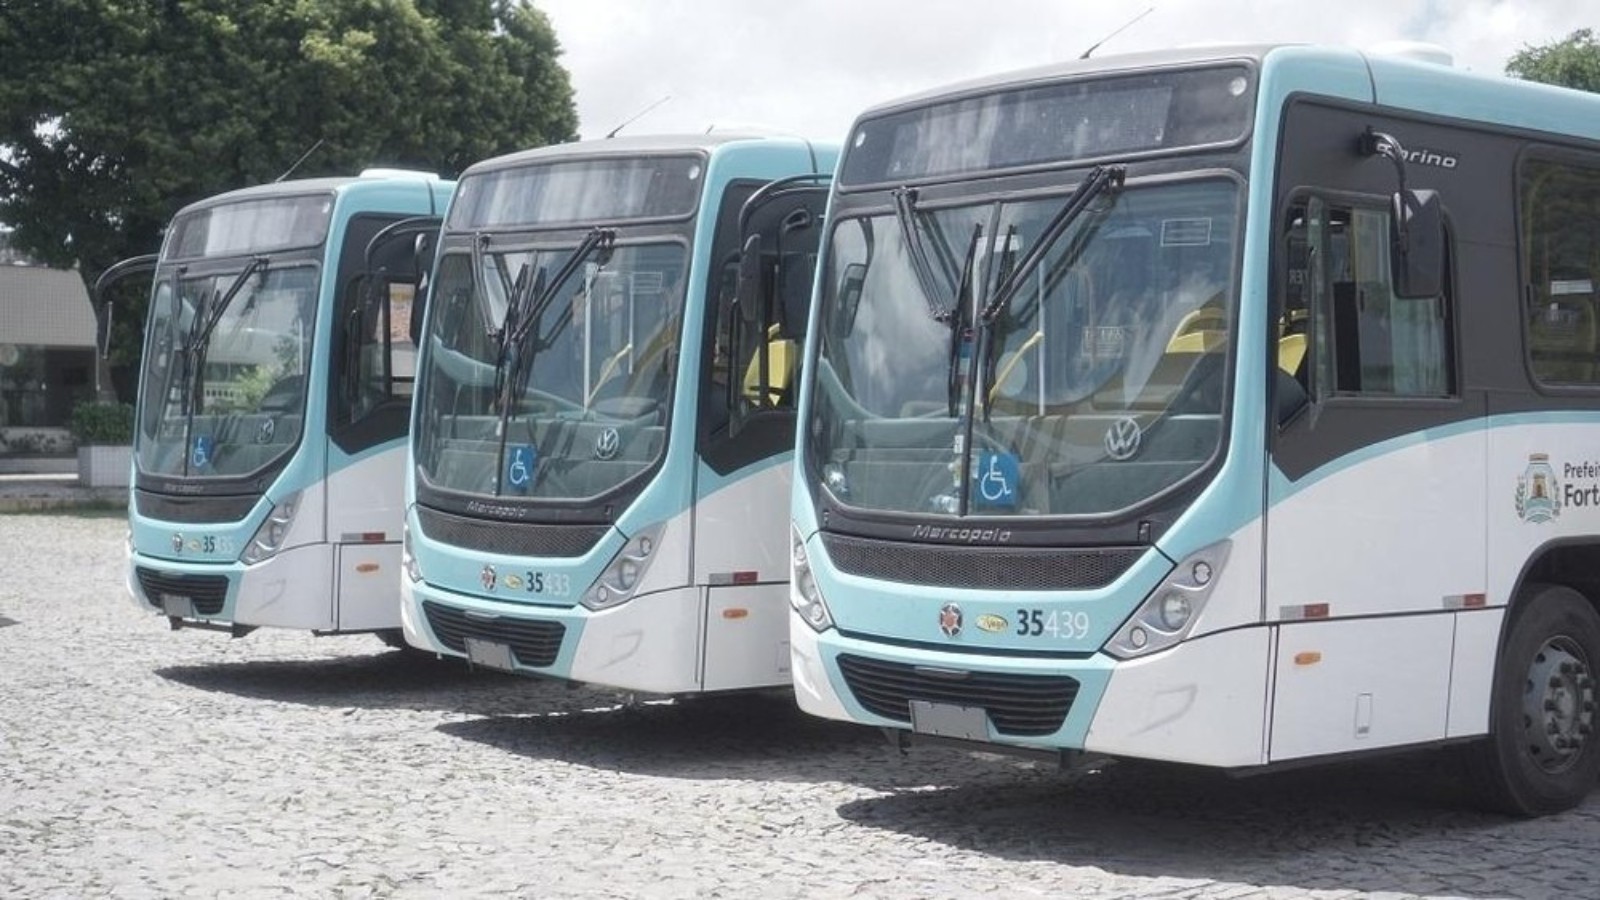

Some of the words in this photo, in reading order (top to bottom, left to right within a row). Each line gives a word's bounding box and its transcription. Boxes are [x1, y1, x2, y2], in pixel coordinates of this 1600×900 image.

[1564, 484, 1600, 507] Fort
[912, 524, 1012, 542] Marcopolo
[1016, 608, 1089, 639] 35439
